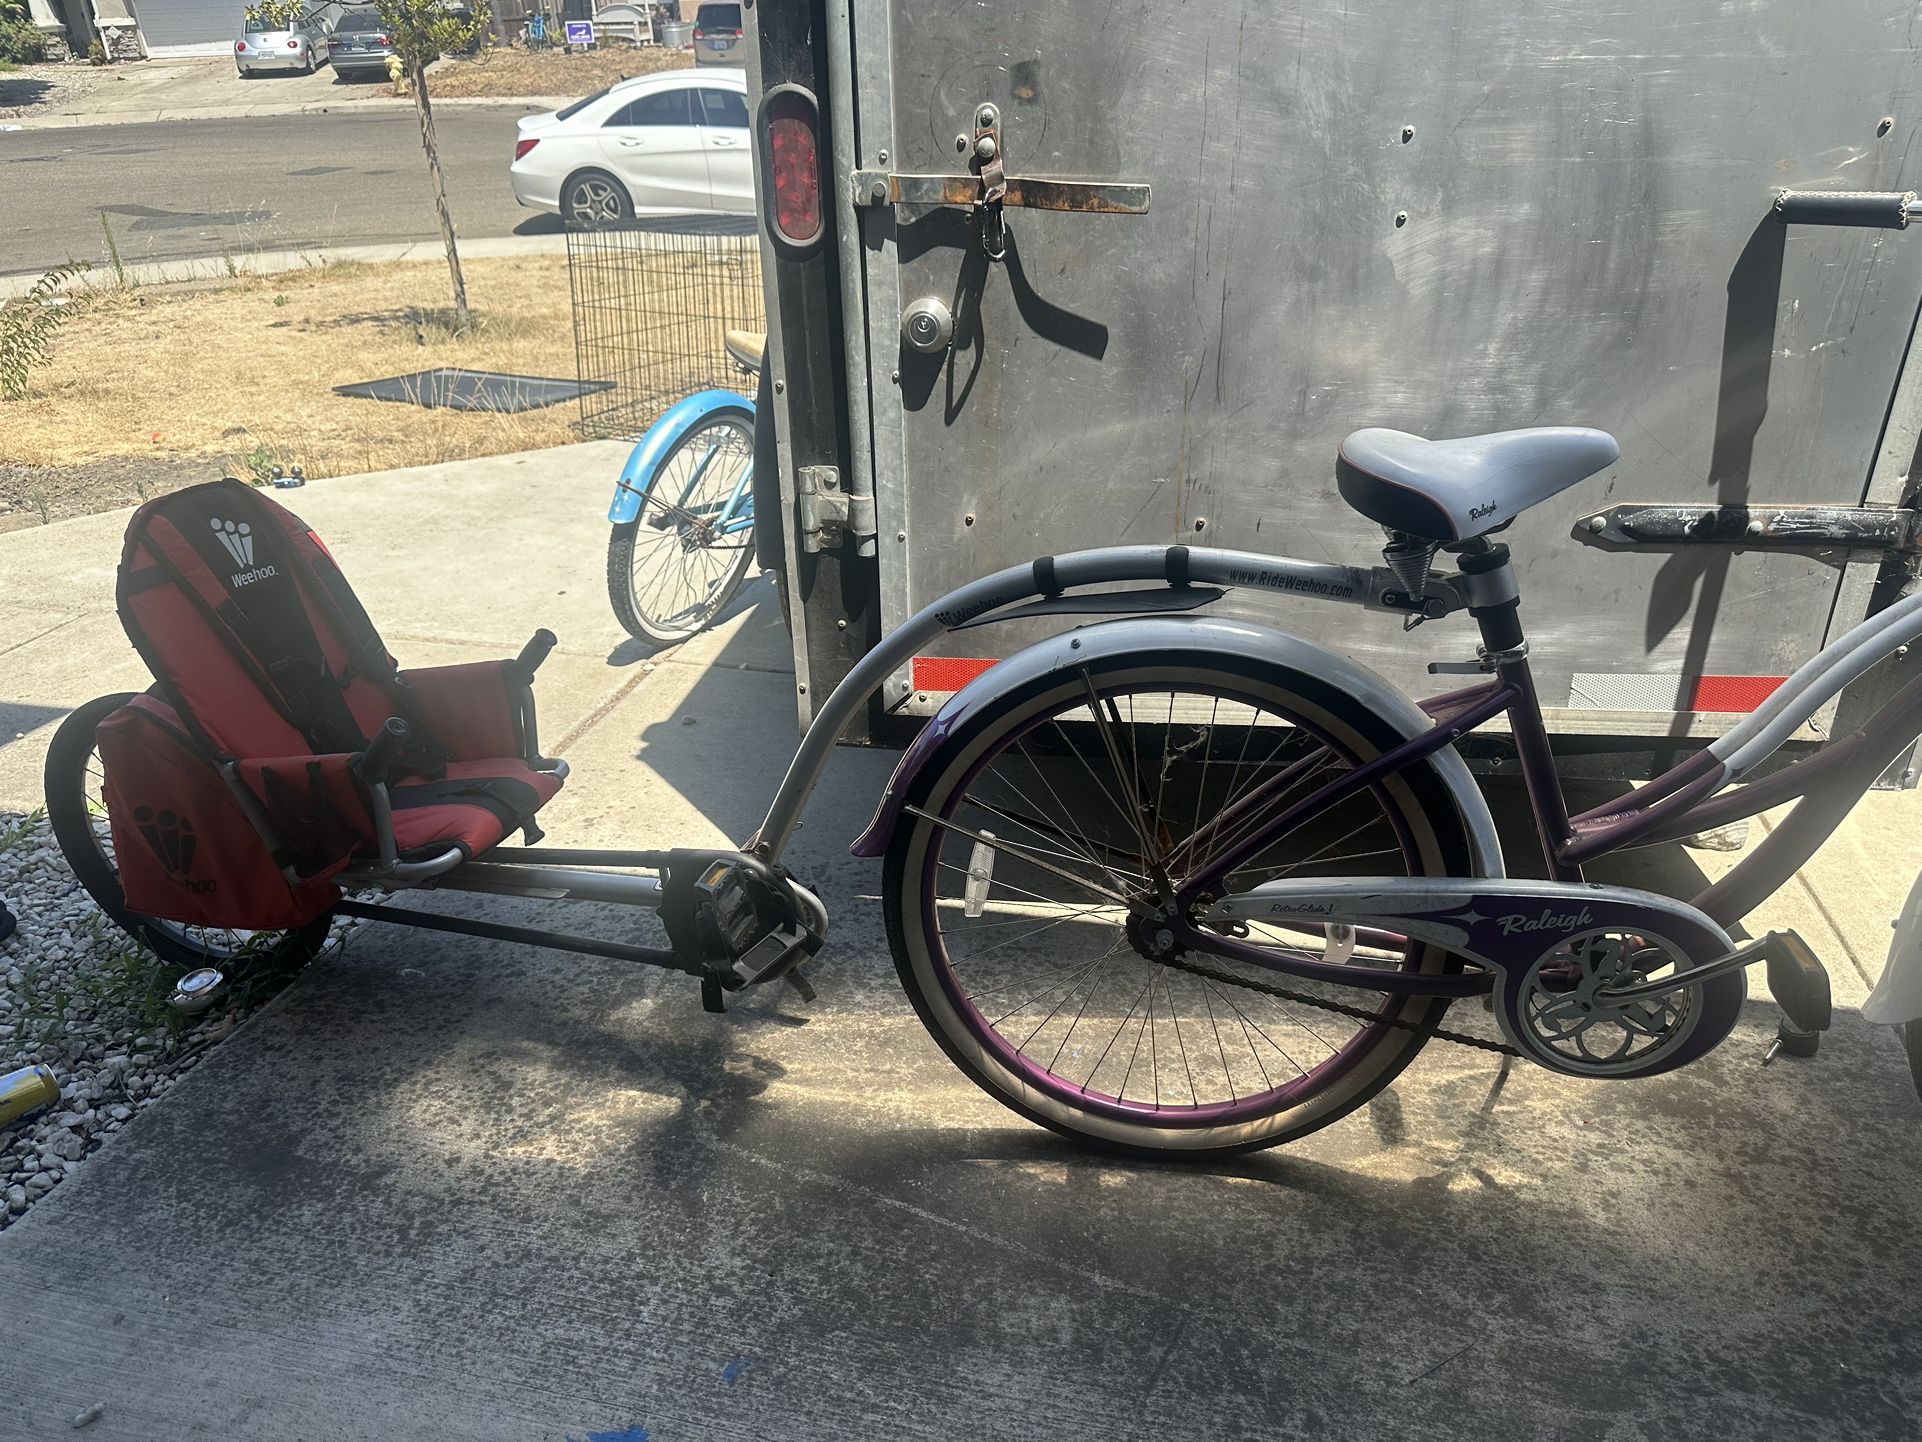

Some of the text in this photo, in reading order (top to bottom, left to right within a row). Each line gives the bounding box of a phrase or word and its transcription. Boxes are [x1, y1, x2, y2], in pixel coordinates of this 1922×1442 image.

[1469, 499, 1497, 521] Raleigh
[1229, 569, 1353, 598] www.RideWeehoo.com
[1496, 906, 1593, 936] Raleigh
